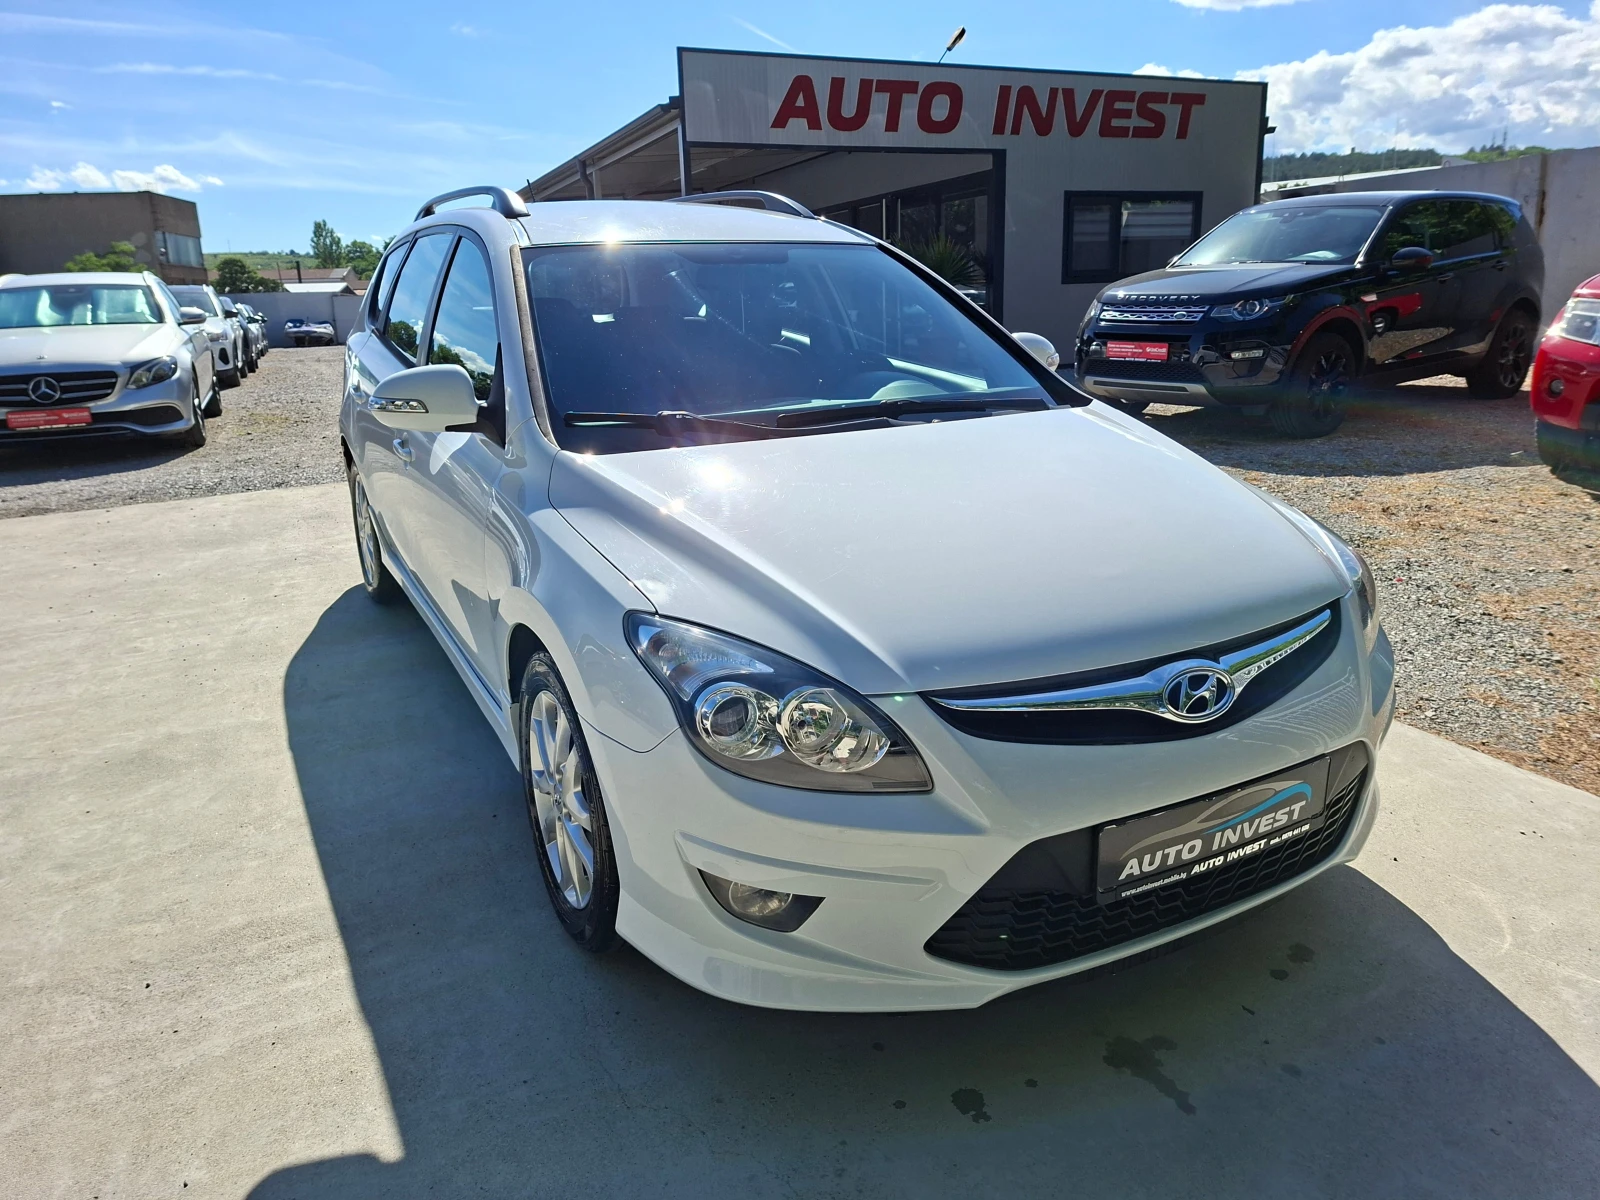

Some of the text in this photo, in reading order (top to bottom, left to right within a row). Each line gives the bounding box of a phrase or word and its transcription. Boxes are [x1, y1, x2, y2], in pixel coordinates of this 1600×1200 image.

[770, 74, 1206, 140] AUTO INVEST
[1117, 294, 1201, 302] DISCOVERY
[1118, 800, 1306, 880] AUTO INVEST
[1190, 855, 1224, 875] AUTO
[1226, 838, 1269, 862] INVEST
